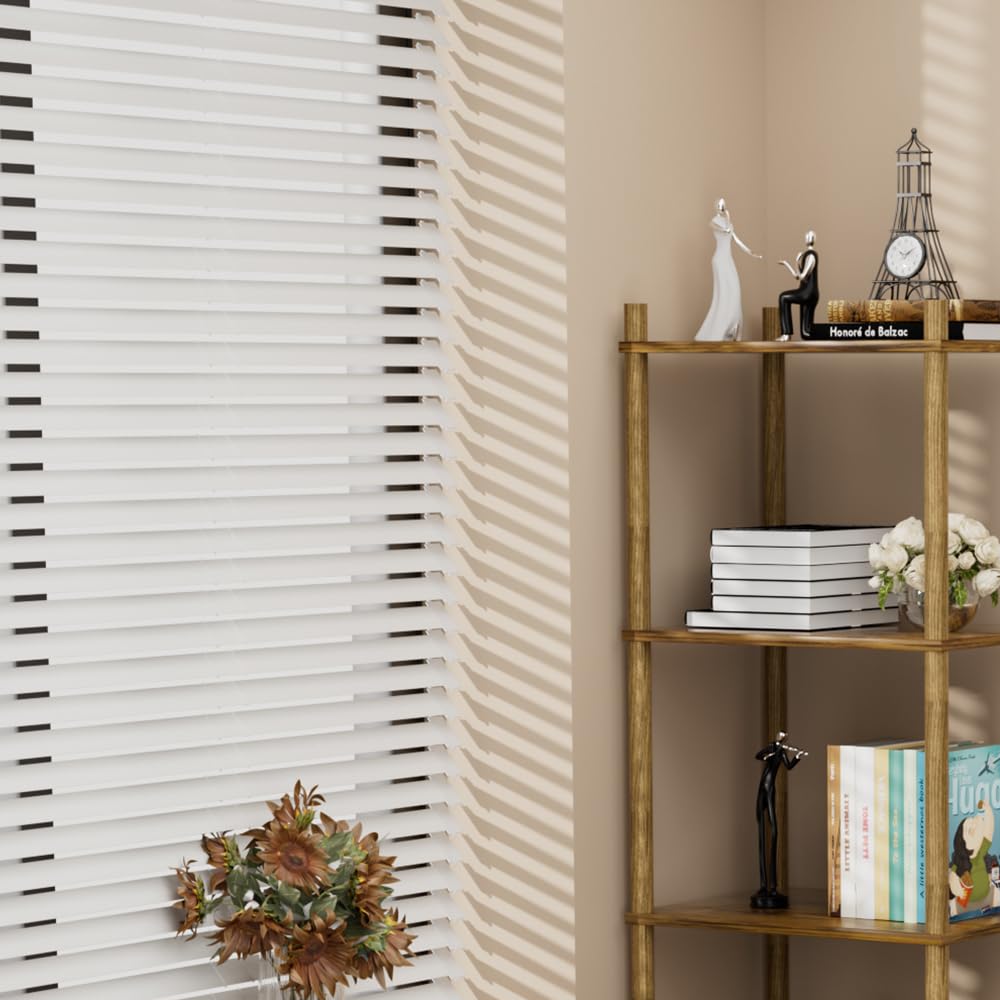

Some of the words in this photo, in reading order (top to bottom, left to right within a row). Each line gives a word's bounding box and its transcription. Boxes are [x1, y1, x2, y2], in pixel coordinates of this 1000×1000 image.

[829, 326, 862, 337] Honoré
[864, 325, 876, 337] de
[878, 325, 908, 337] Balzac
